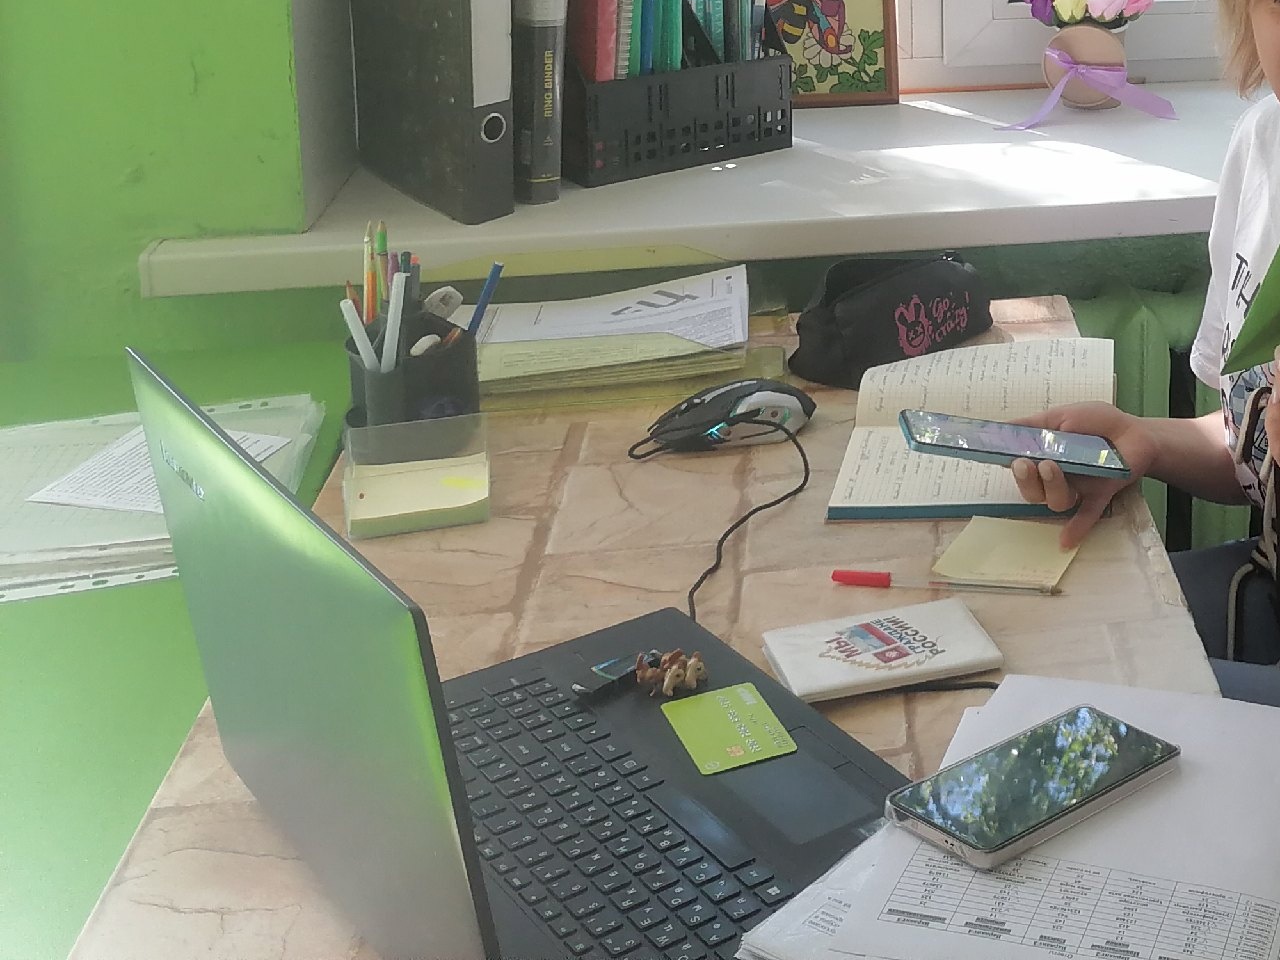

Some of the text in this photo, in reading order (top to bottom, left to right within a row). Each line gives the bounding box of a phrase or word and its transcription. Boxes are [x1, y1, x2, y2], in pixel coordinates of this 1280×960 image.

[544, 49, 554, 117] RING BINDER
[824, 636, 862, 659] МЫ
[869, 618, 926, 654] ГРАЖДАНЕ
[882, 615, 946, 657] РОССИИ!
